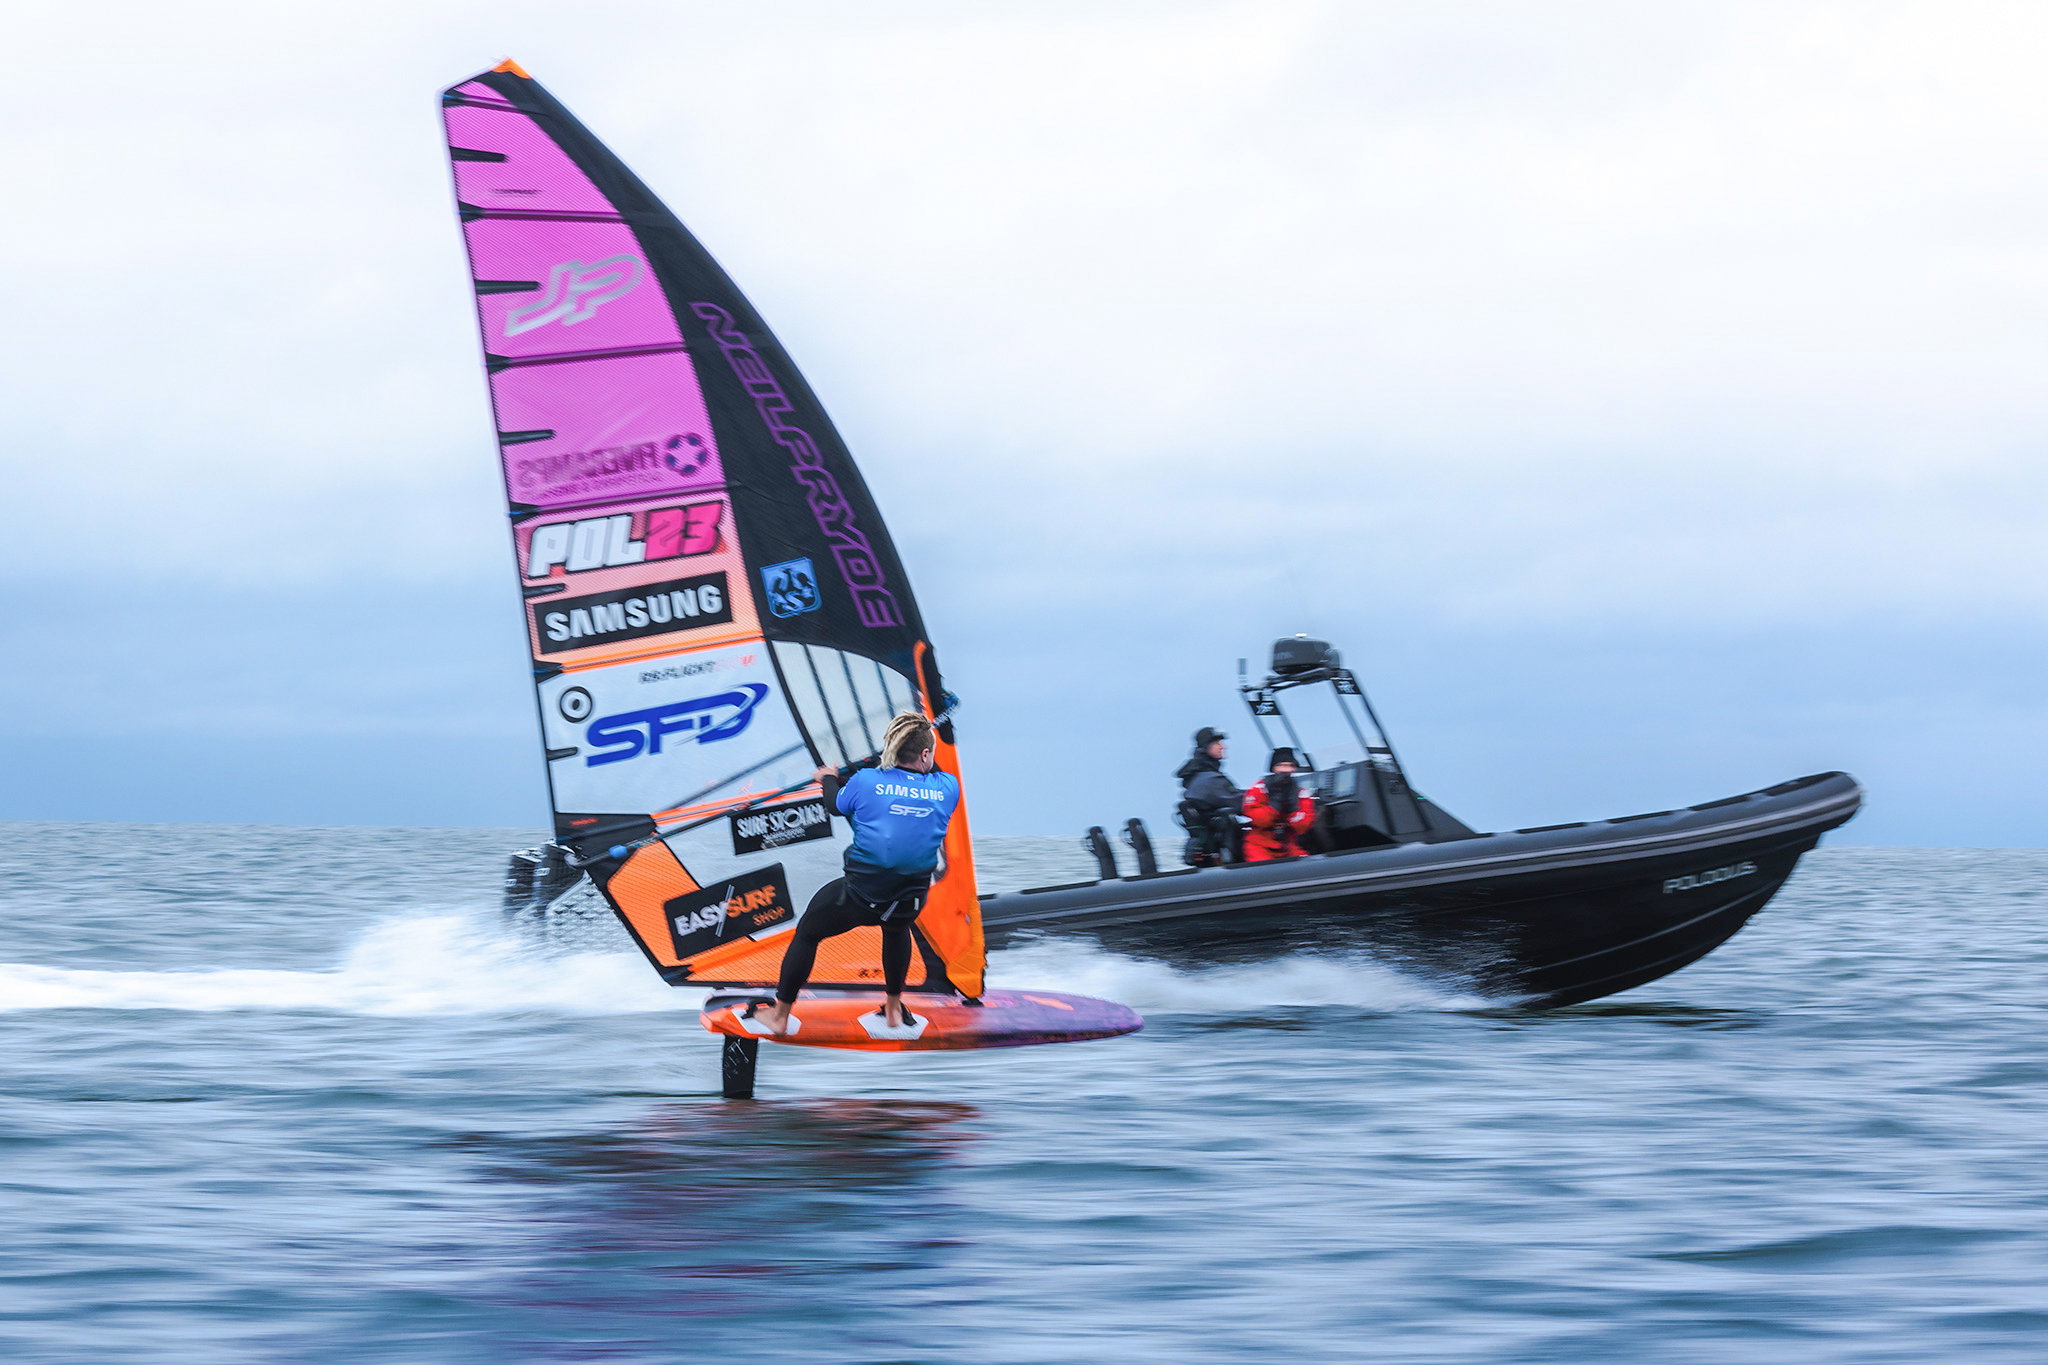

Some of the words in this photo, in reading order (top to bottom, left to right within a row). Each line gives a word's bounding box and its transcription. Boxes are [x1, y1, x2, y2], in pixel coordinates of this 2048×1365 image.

[504, 253, 646, 337] JP
[688, 302, 906, 628] NEILPRYDE
[545, 584, 723, 642] SAMSUNG
[586, 682, 769, 768] SFD
[875, 783, 945, 802] SAMSUNG
[674, 900, 729, 937] EASY
[726, 884, 777, 918] SURF
[752, 905, 785, 926] SHOP
